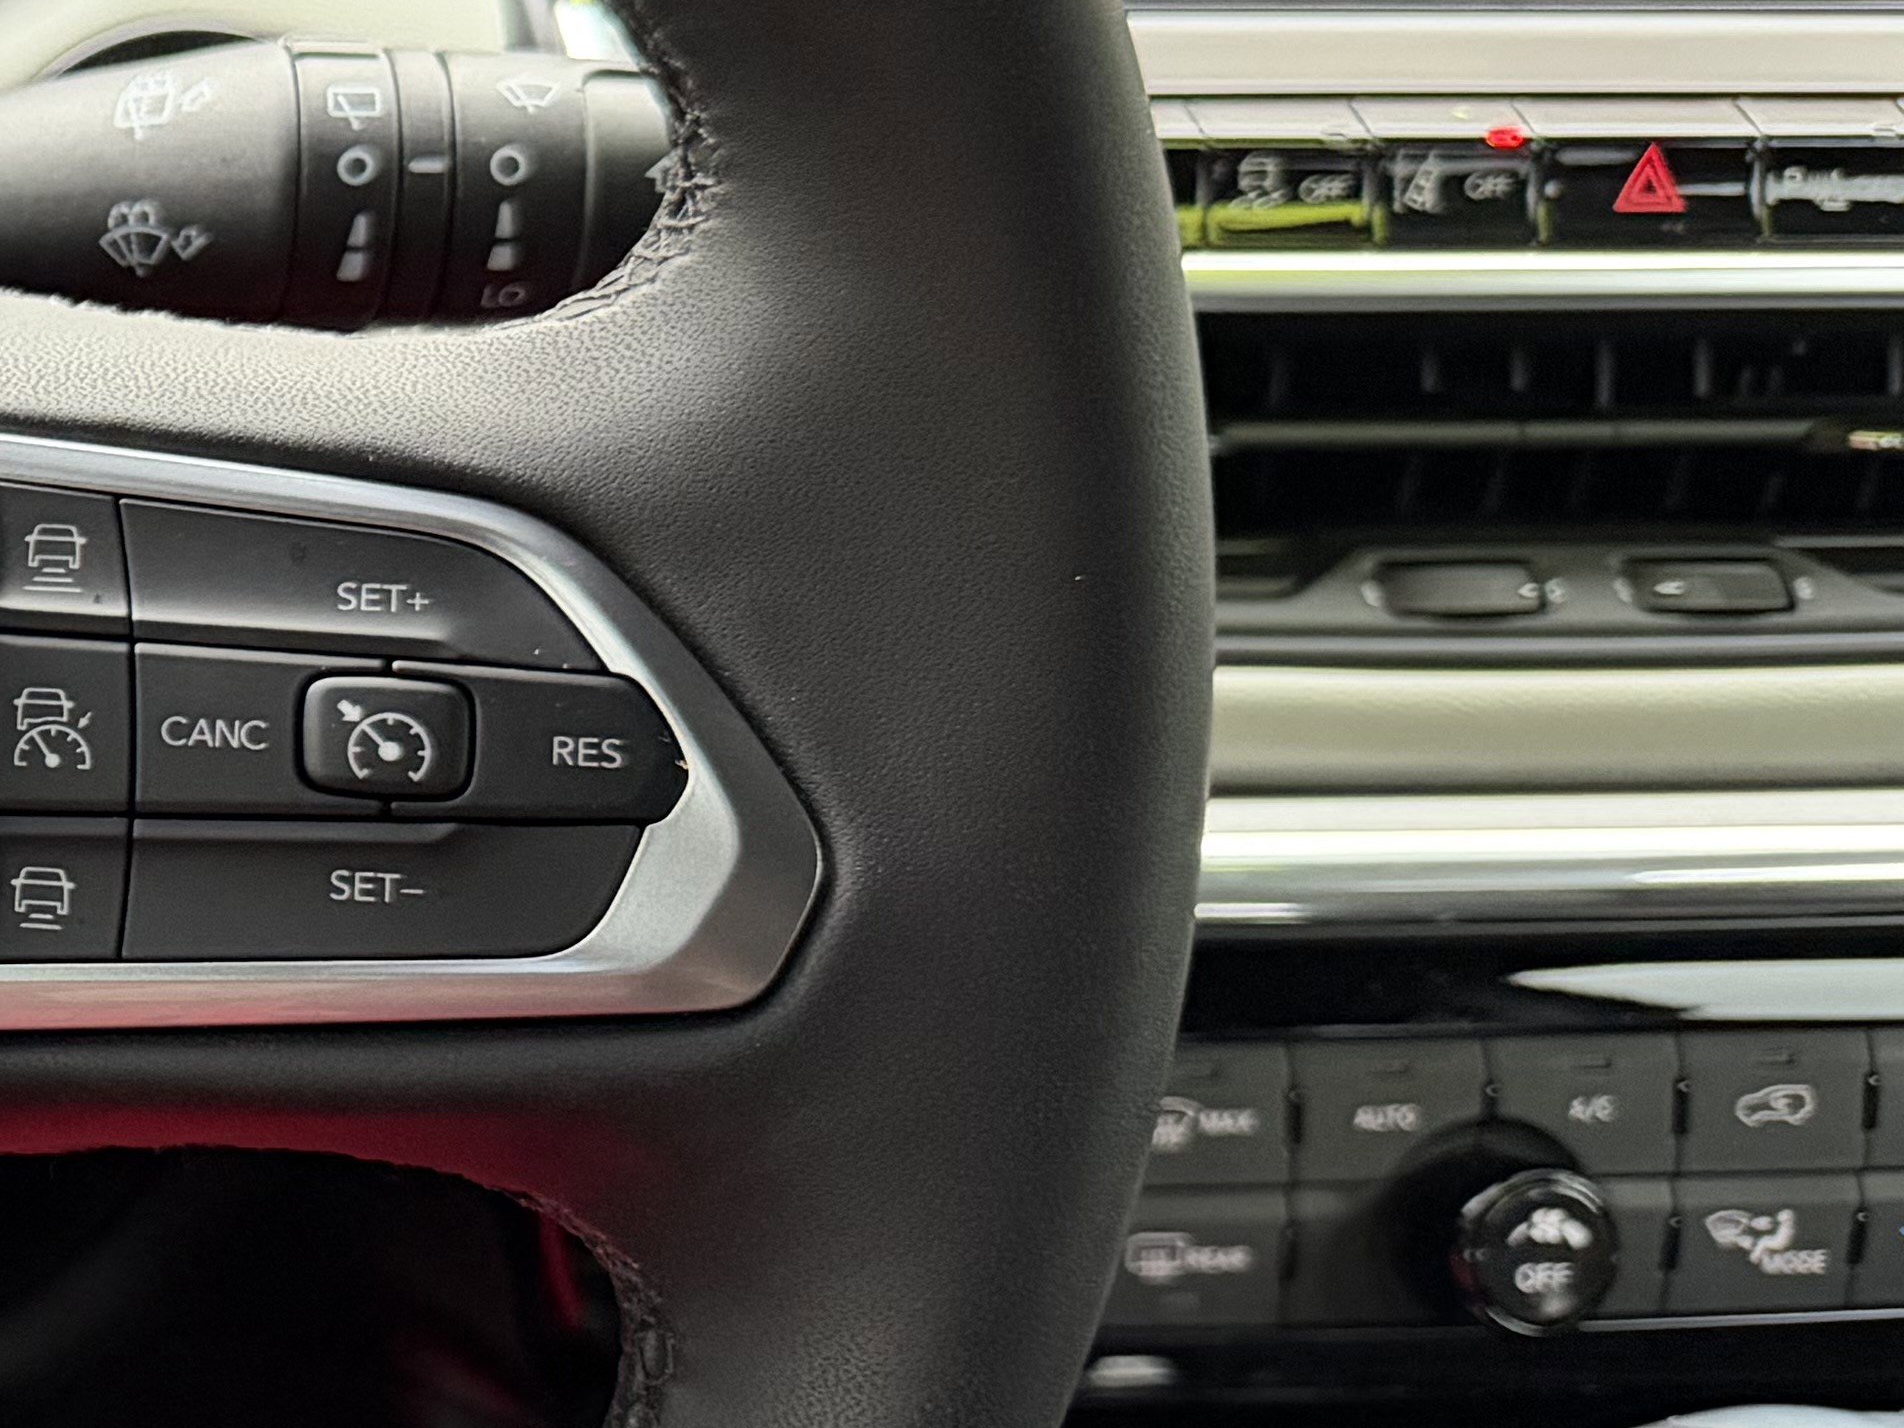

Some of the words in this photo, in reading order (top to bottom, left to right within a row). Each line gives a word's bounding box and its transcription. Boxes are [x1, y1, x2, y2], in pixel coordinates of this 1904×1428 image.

[336, 581, 432, 616] SET+
[159, 714, 270, 753] CANC
[551, 734, 624, 770] RES
[1353, 1102, 1422, 1132] AUTO
[1514, 1261, 1574, 1294] OFF
[1760, 1248, 1827, 1274] MODE
